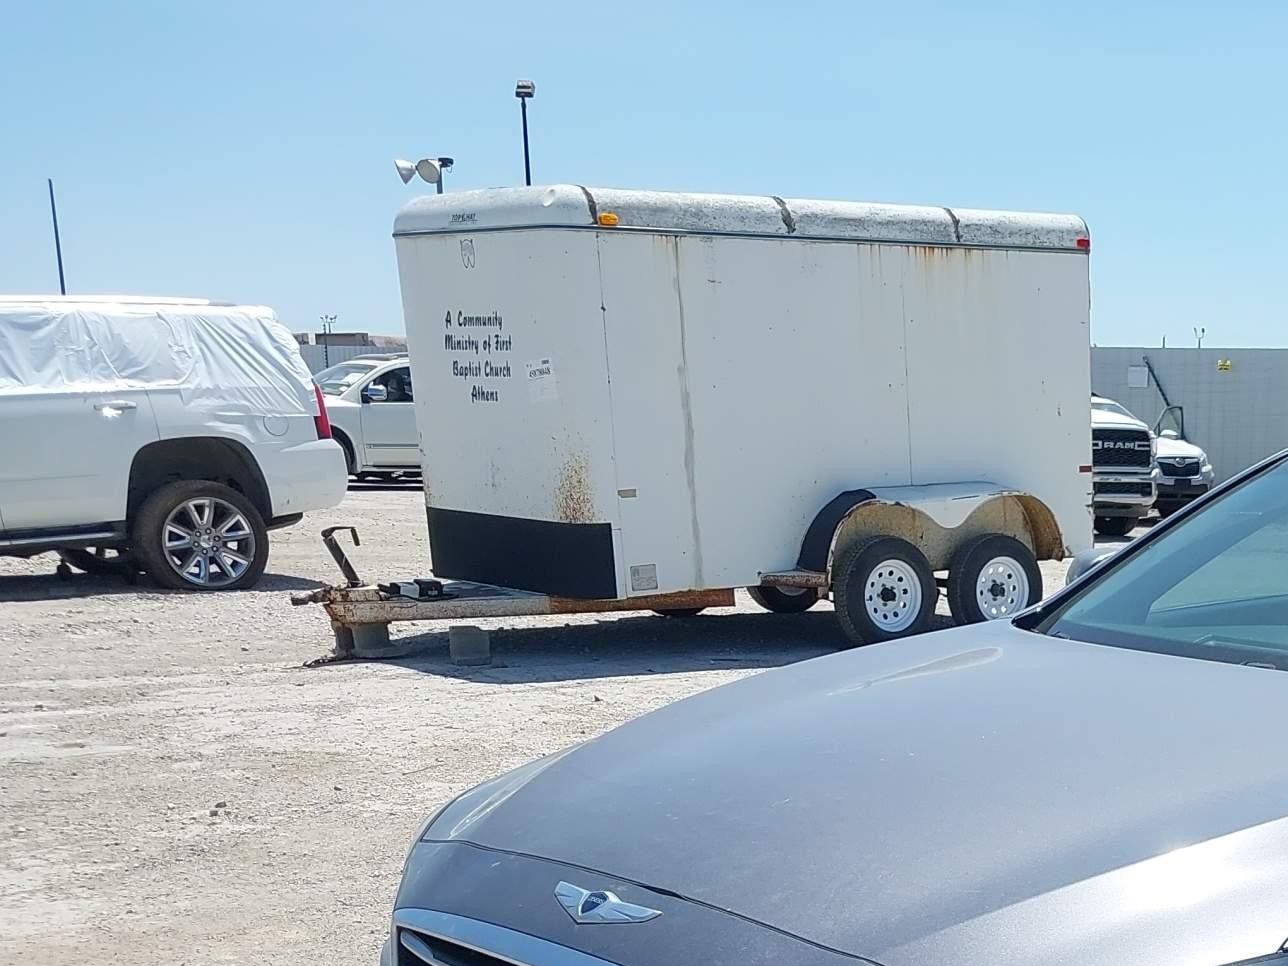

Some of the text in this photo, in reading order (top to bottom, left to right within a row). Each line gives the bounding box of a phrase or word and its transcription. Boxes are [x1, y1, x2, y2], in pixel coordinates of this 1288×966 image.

[445, 310, 503, 331] A Community
[444, 334, 512, 355] Ministry of First
[452, 360, 481, 380] Baptist
[484, 360, 511, 378] Church
[471, 385, 499, 403] Athens
[1103, 441, 1135, 449] RAM
